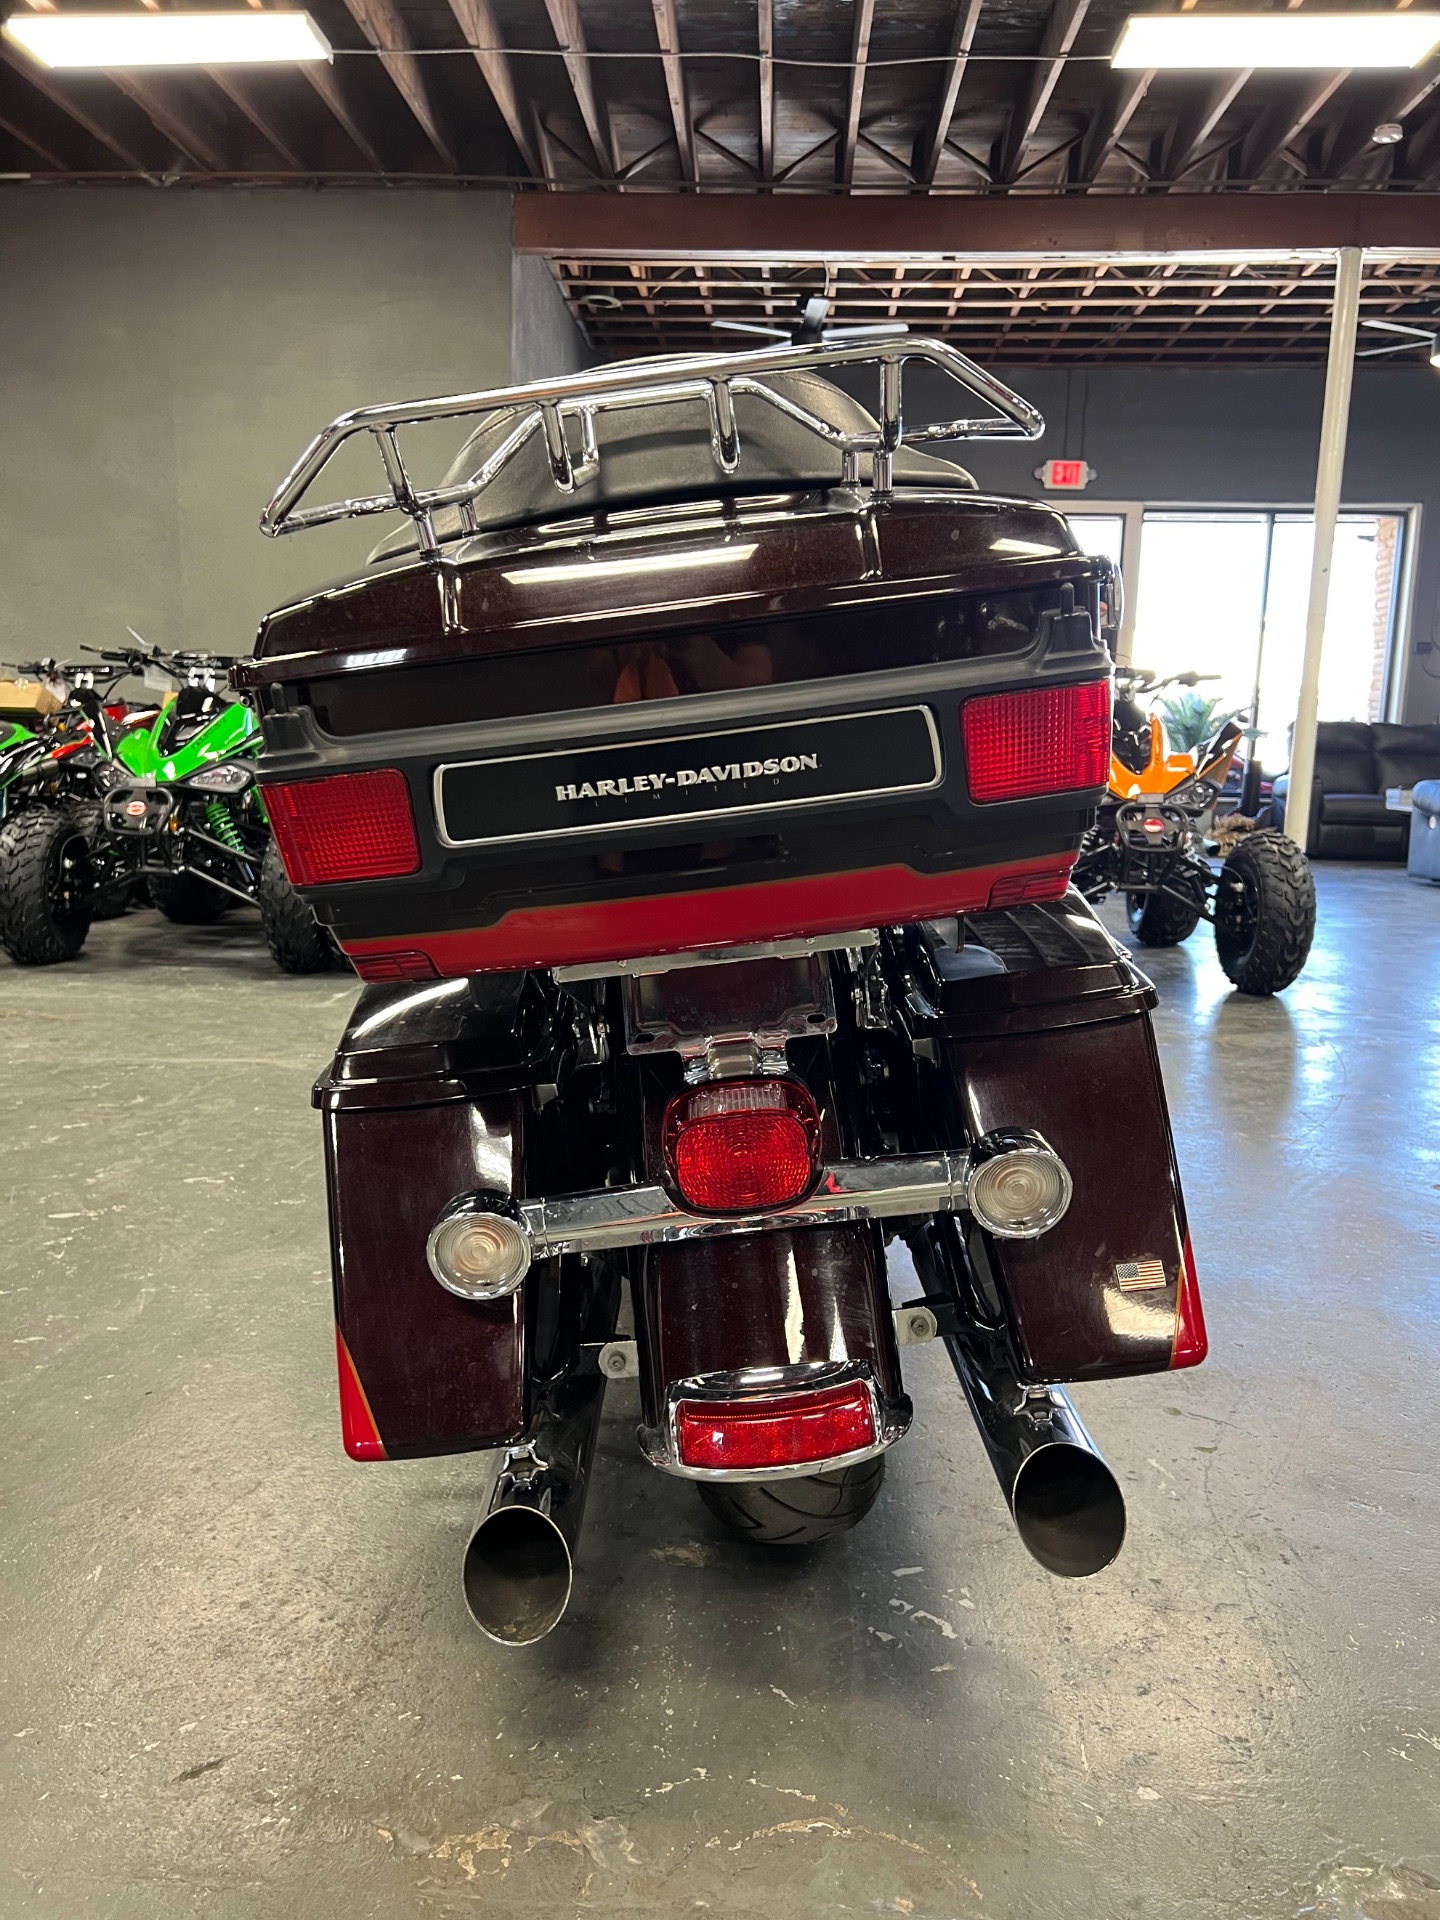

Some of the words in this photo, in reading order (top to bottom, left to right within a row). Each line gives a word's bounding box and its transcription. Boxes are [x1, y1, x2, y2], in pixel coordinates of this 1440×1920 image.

[1052, 462, 1082, 485] EXIT
[555, 753, 818, 801] HARLEY-DAVIDSON
[594, 777, 780, 808] LIMITED
